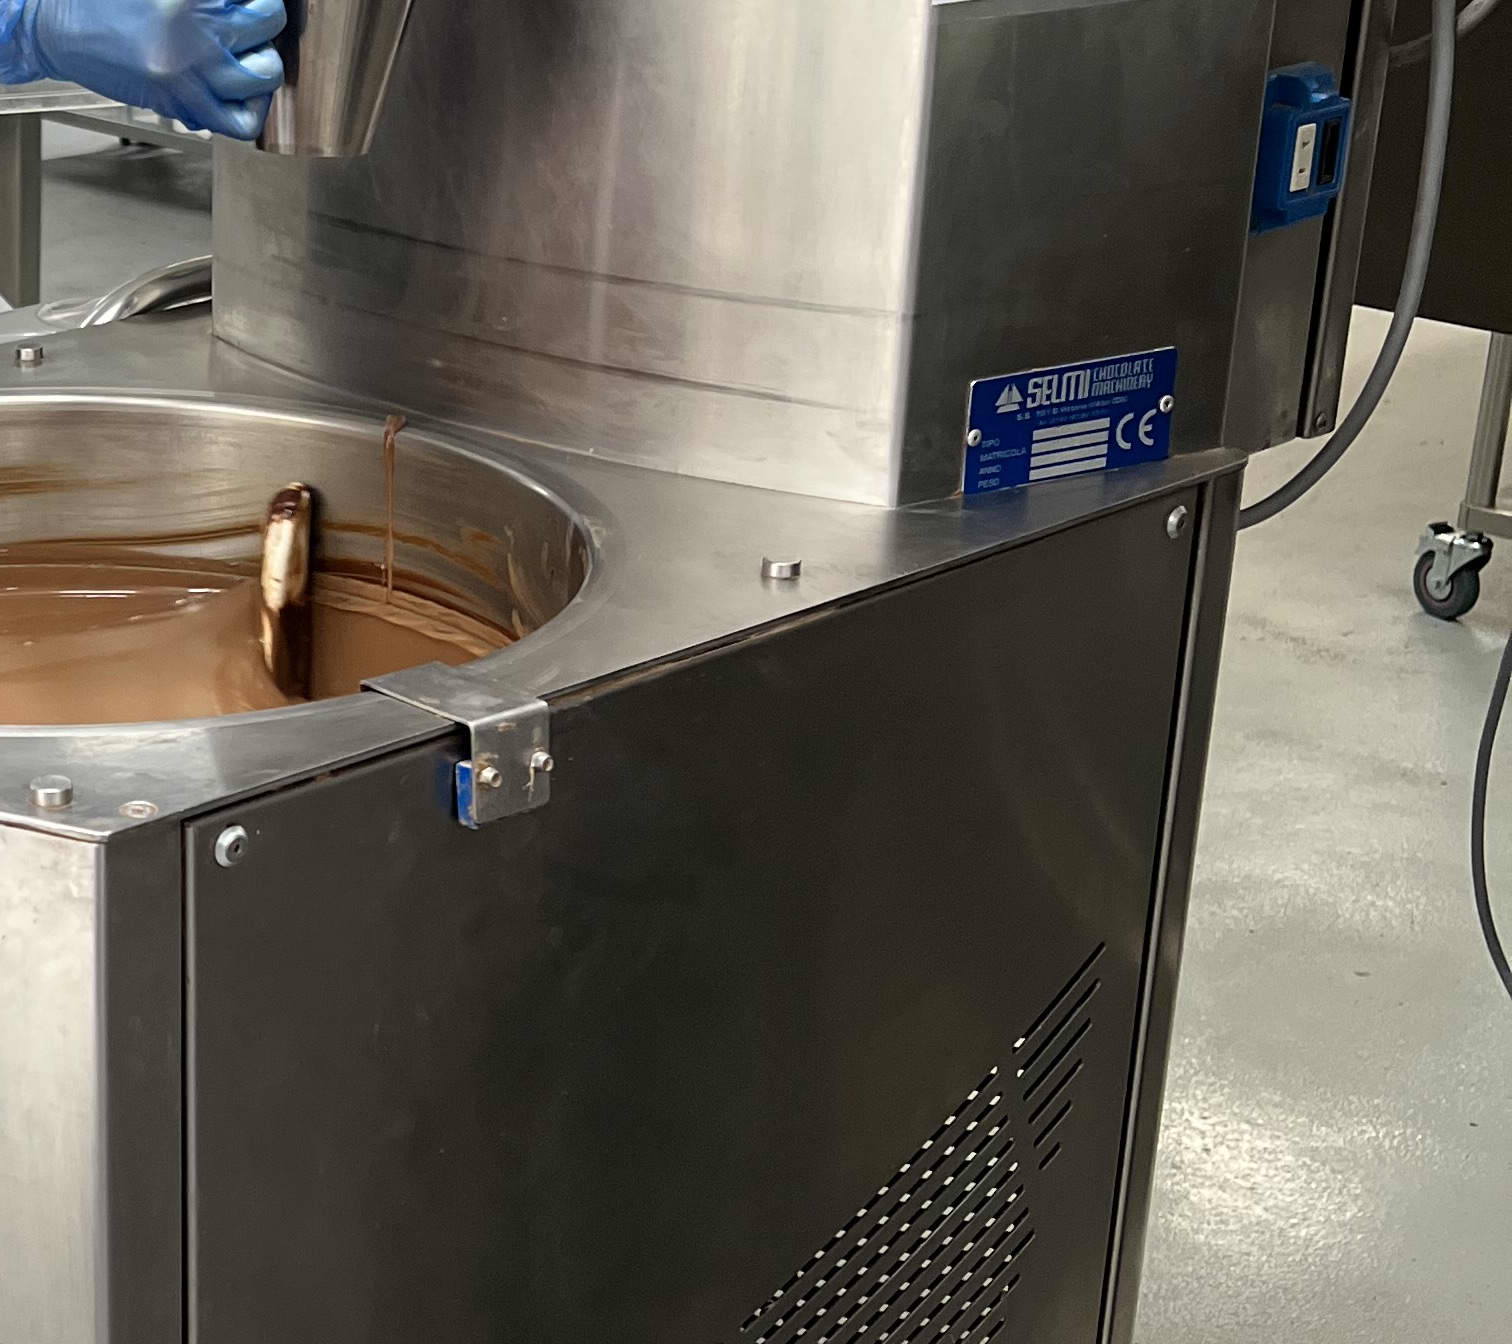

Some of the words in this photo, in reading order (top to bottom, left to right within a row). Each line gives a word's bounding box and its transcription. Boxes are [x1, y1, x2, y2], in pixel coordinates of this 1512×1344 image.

[1093, 358, 1155, 382] CHOCOLATE
[1026, 369, 1091, 409] SELMI
[1091, 374, 1154, 396] MACHINERY
